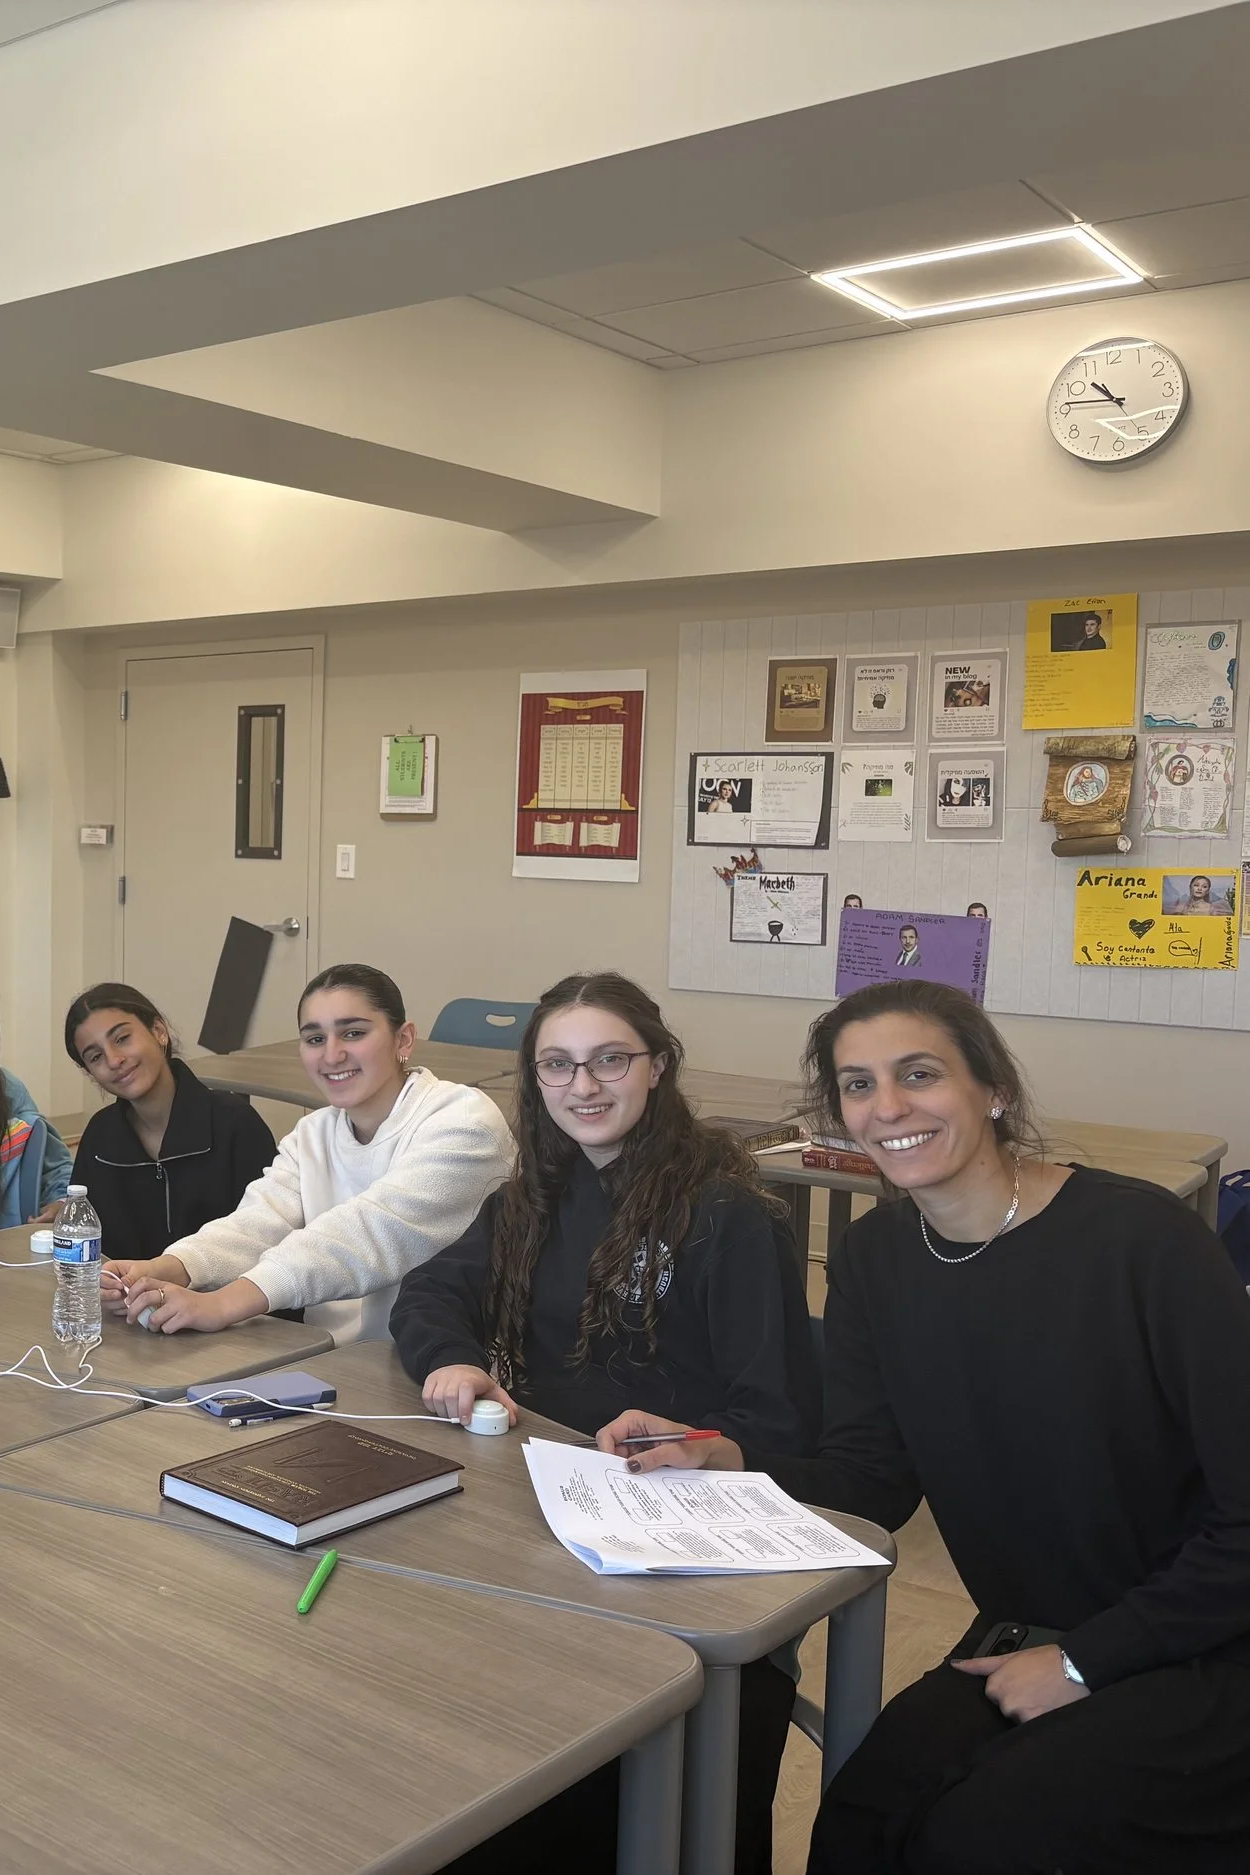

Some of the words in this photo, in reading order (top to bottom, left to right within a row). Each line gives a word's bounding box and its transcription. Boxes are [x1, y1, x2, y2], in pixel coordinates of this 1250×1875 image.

[1105, 349, 1122, 366] 12
[1083, 360, 1097, 378] 11
[1151, 360, 1165, 378] 2
[1065, 380, 1086, 398] 10
[1161, 381, 1174, 398] 3
[1059, 403, 1072, 419] 9
[1154, 409, 1167, 421] 4
[1068, 424, 1080, 439] 8
[1137, 425, 1150, 441] 5
[1089, 435, 1100, 451] 7
[1112, 436, 1125, 452] 6
[945, 666, 971, 675] NEW
[714, 758, 765, 773] Scarlett
[772, 759, 824, 774] Johansson
[759, 875, 796, 892] Macbeth
[1076, 869, 1147, 888] Ariana
[1122, 888, 1158, 899] Grande
[875, 912, 904, 921] ADAM
[1096, 941, 1114, 954] Soy
